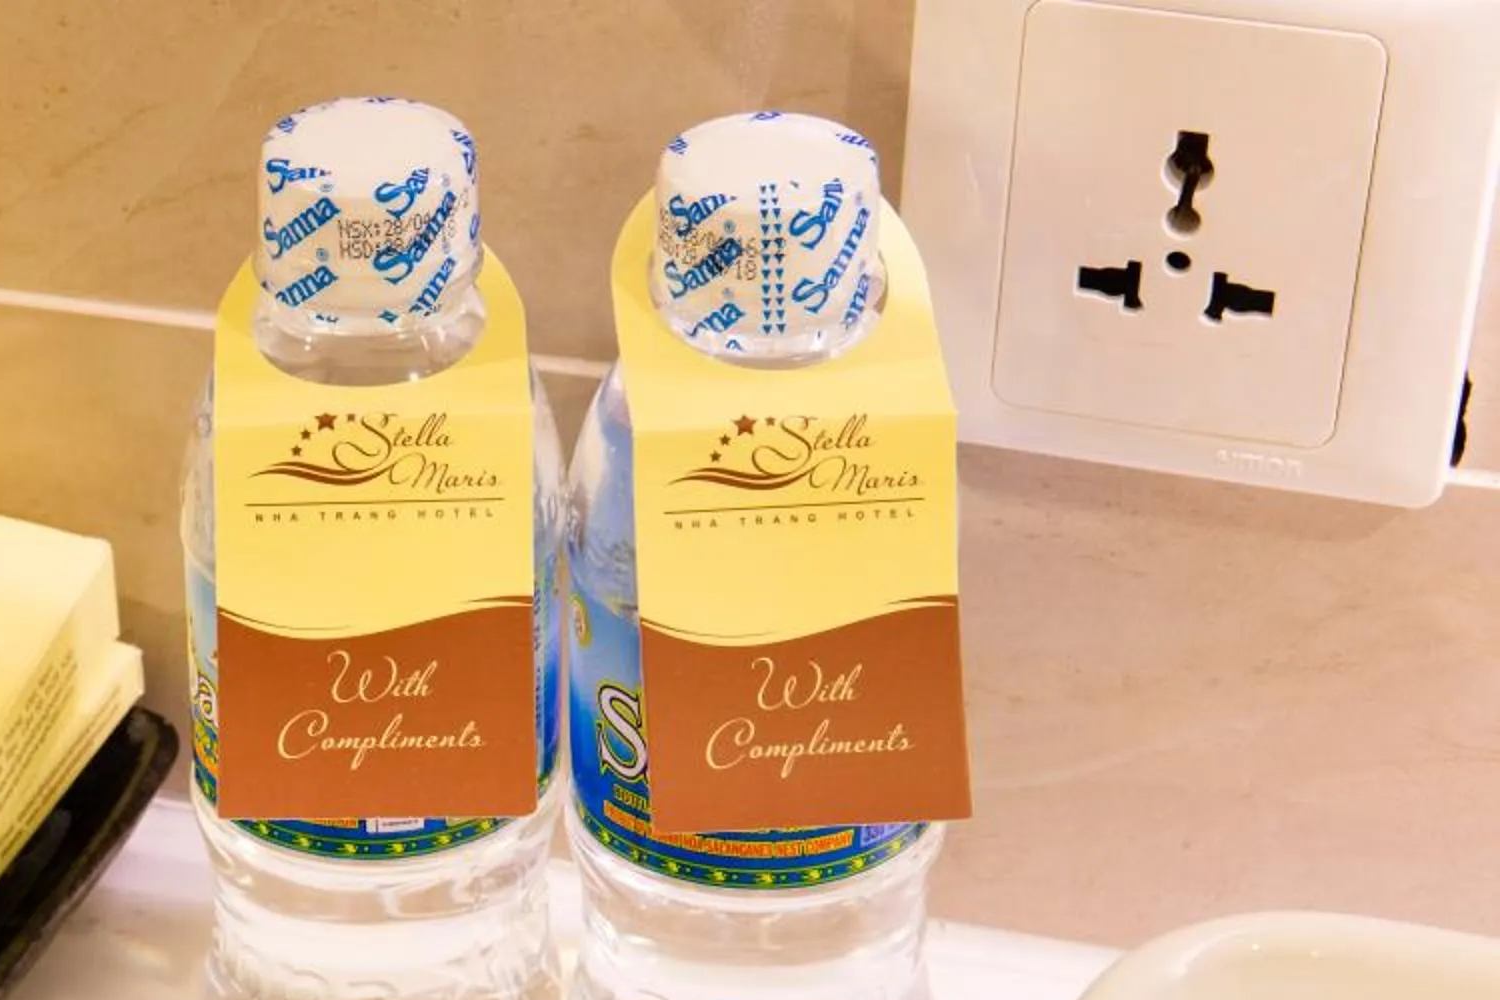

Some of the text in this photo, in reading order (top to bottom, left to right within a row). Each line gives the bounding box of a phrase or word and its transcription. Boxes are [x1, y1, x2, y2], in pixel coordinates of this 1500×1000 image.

[264, 197, 341, 260] Sanna
[373, 191, 457, 285] Sanna
[664, 237, 743, 299] Sanna
[791, 206, 870, 315] Sanna
[332, 412, 452, 473] Stella
[752, 412, 873, 475] Stella
[389, 453, 500, 494] Maris
[809, 455, 921, 496] Maris
[255, 508, 494, 524] NHA TRANG HOTEL
[674, 508, 916, 530] NHA TRANG HOTEL
[326, 649, 438, 704] With
[751, 657, 863, 711] With
[277, 709, 486, 771] Compliments
[705, 716, 914, 779] Compliments
